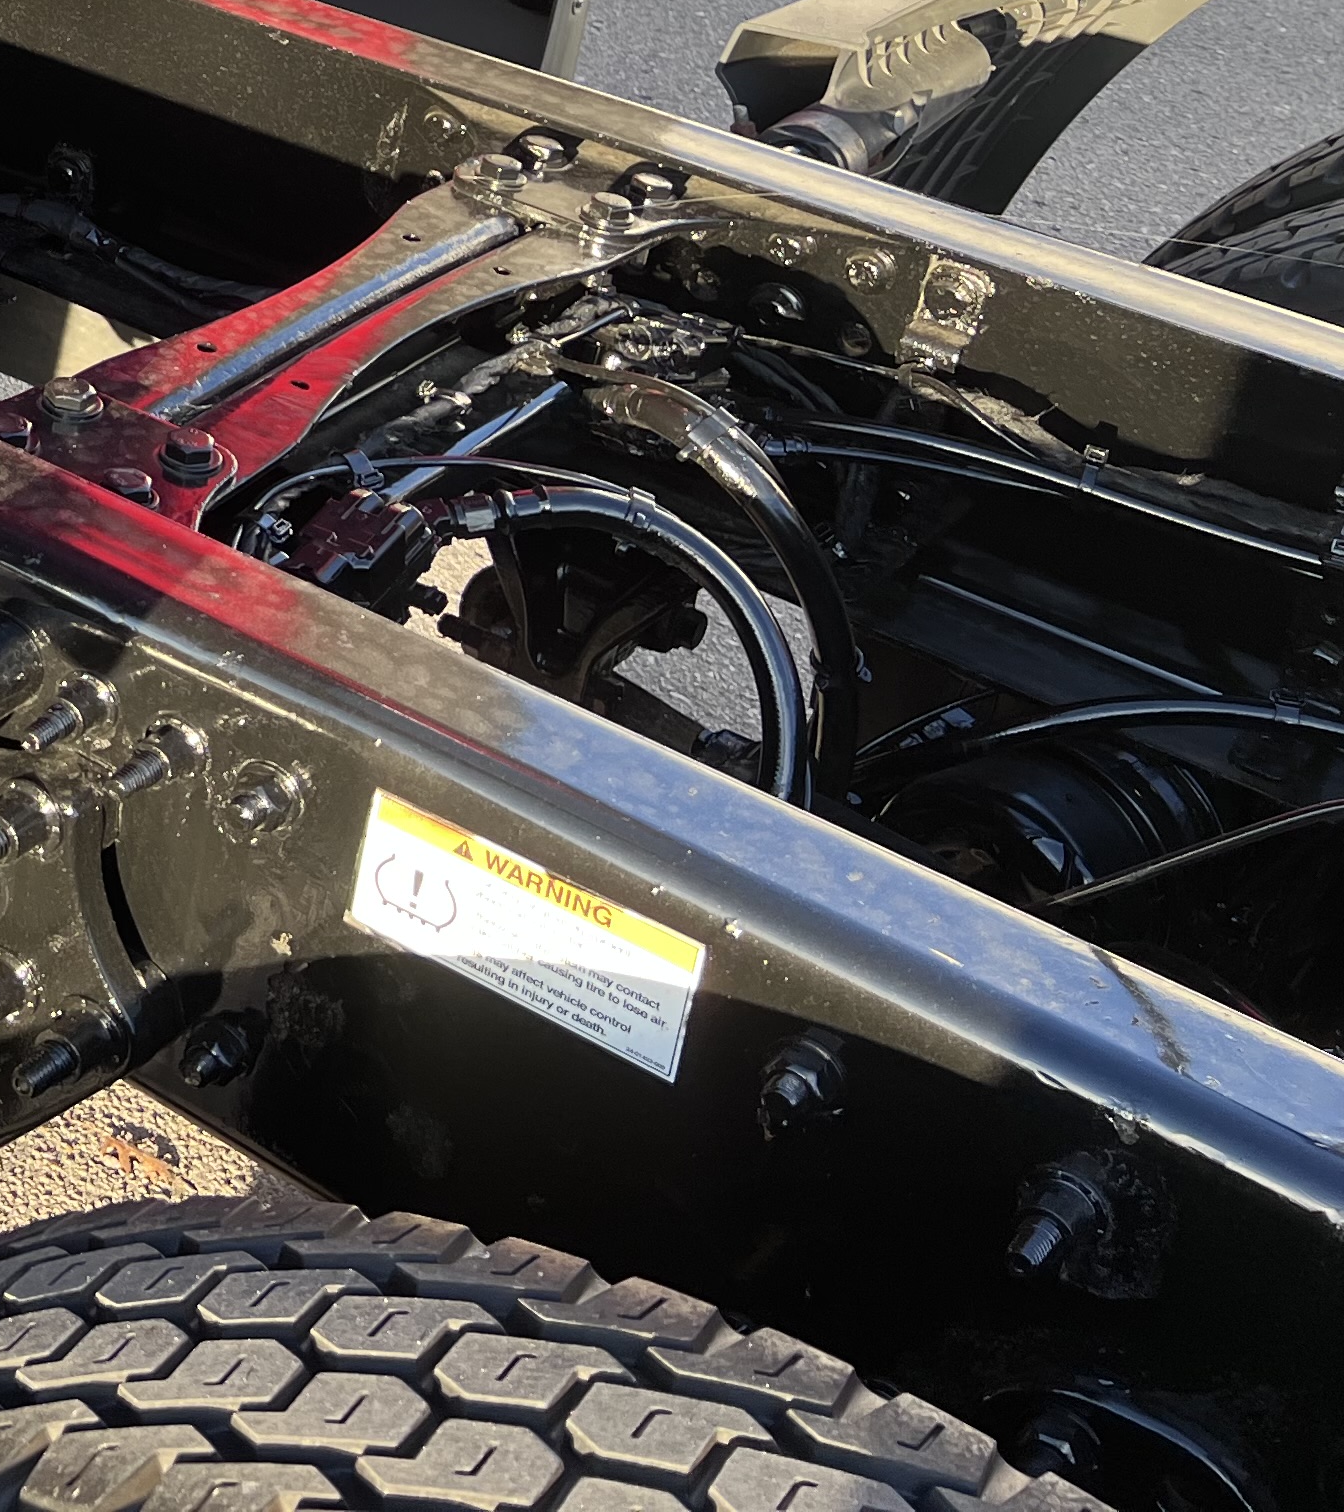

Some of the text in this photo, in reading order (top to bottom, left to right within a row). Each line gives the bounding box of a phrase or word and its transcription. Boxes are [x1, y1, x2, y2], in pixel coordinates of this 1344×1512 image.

[484, 849, 613, 928] WARNING
[456, 954, 607, 1037] resulting in injury or death.
[485, 954, 632, 1034] may affect vehicle control
[537, 959, 583, 988] causing
[586, 979, 606, 998] tire
[608, 991, 621, 1005] to
[623, 999, 649, 1019] lose
[588, 969, 614, 987] may
[616, 982, 661, 1011] contact
